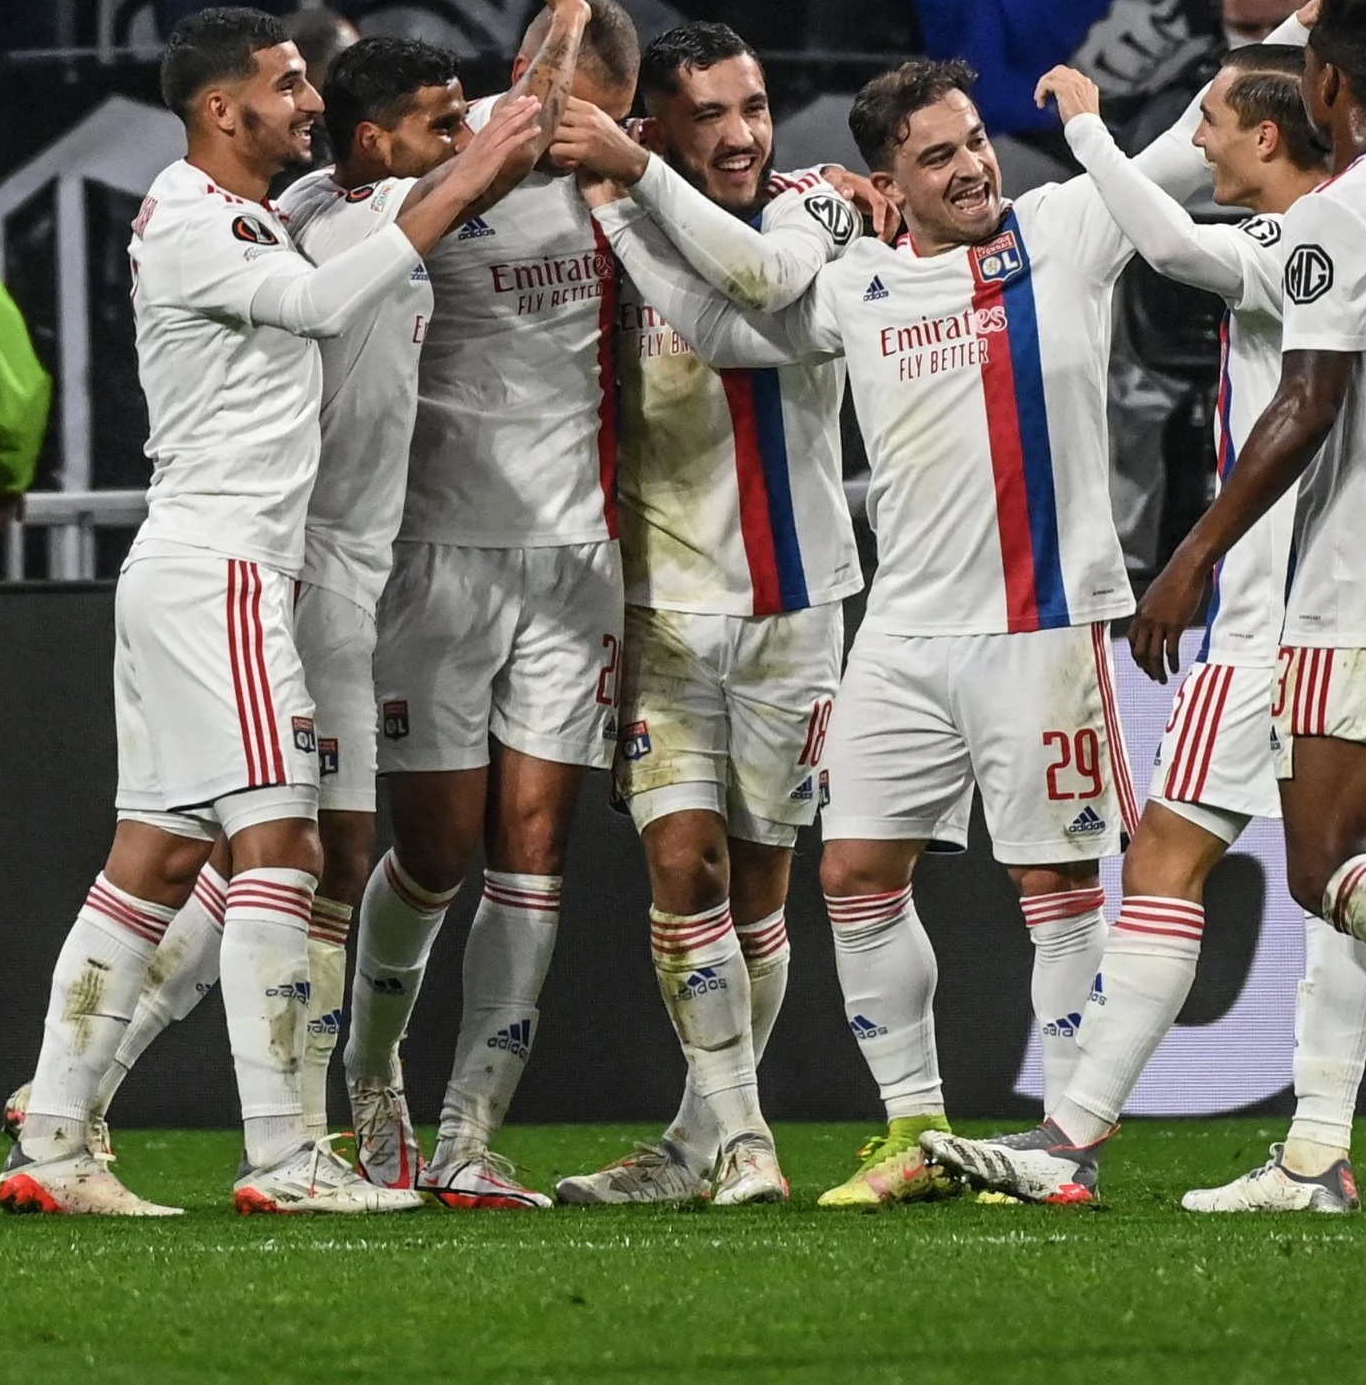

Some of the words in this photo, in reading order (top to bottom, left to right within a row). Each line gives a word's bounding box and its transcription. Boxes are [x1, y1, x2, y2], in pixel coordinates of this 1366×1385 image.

[489, 254, 615, 293] Emirates
[1290, 250, 1327, 298] MG
[639, 333, 664, 358] FLY
[880, 306, 1009, 357] Emirates
[900, 353, 923, 381] FLY
[930, 338, 990, 375] BETTER
[798, 699, 833, 767] 18
[1042, 727, 1103, 801] 29
[1068, 820, 1106, 833] adidas
